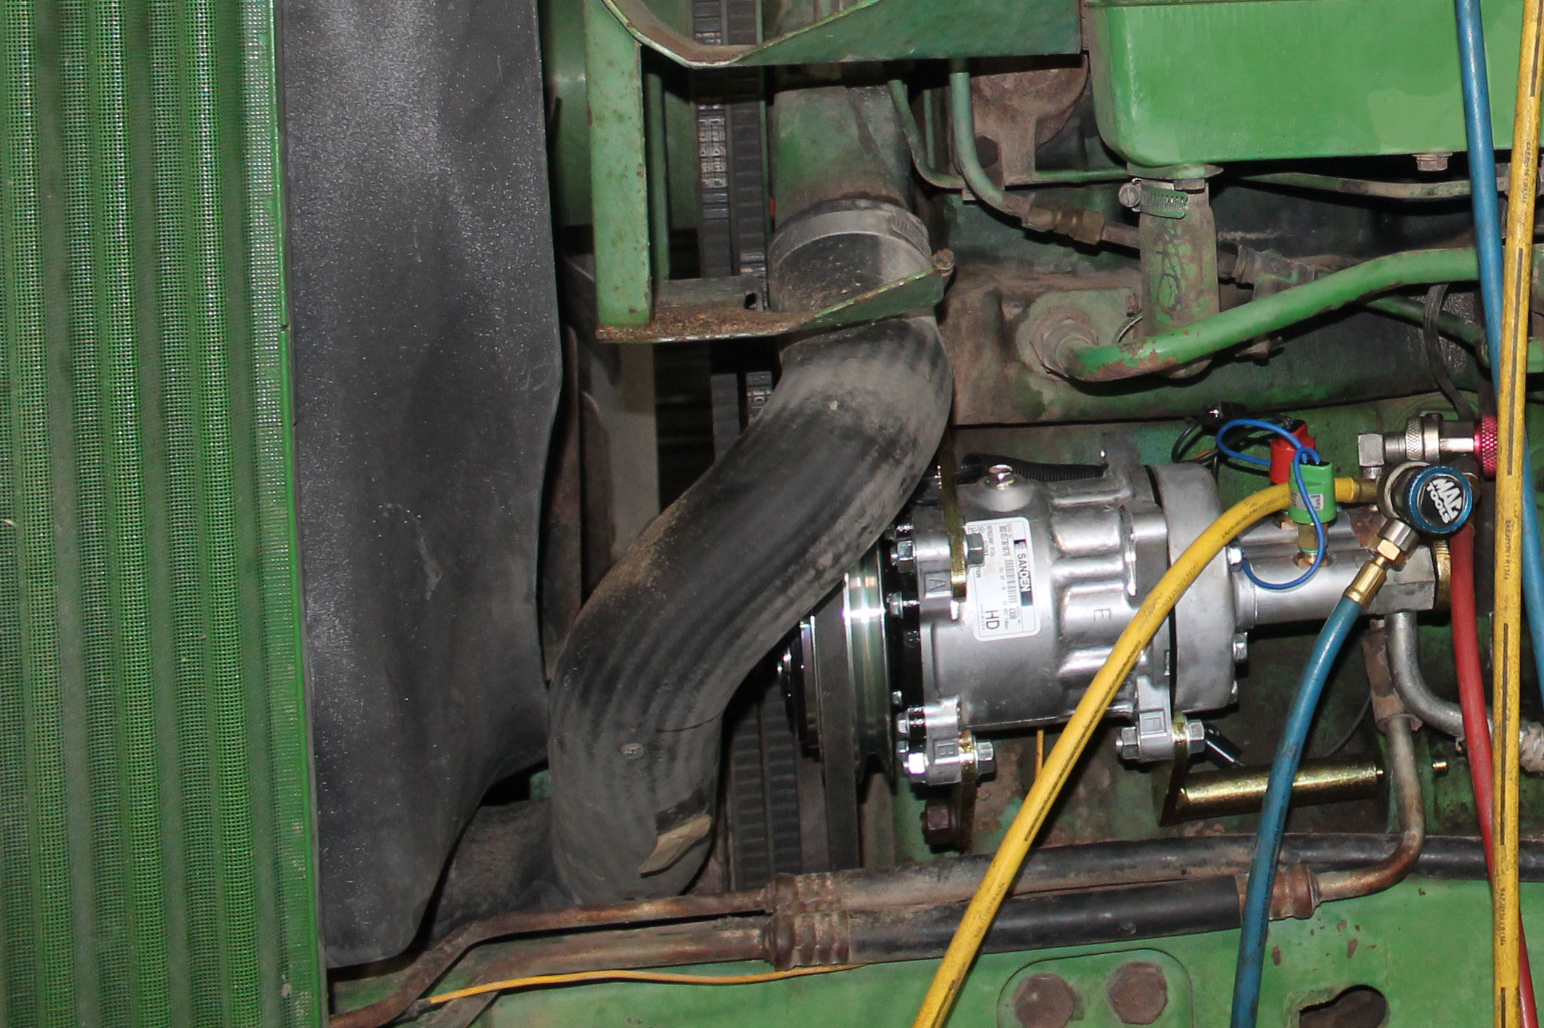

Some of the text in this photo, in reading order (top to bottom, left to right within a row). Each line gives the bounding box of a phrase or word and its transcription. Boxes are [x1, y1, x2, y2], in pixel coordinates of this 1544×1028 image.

[1426, 482, 1452, 524] TOOLS
[1431, 478, 1463, 520] MAC
[1017, 553, 1032, 592] SANDEN
[985, 609, 1000, 631] HD
